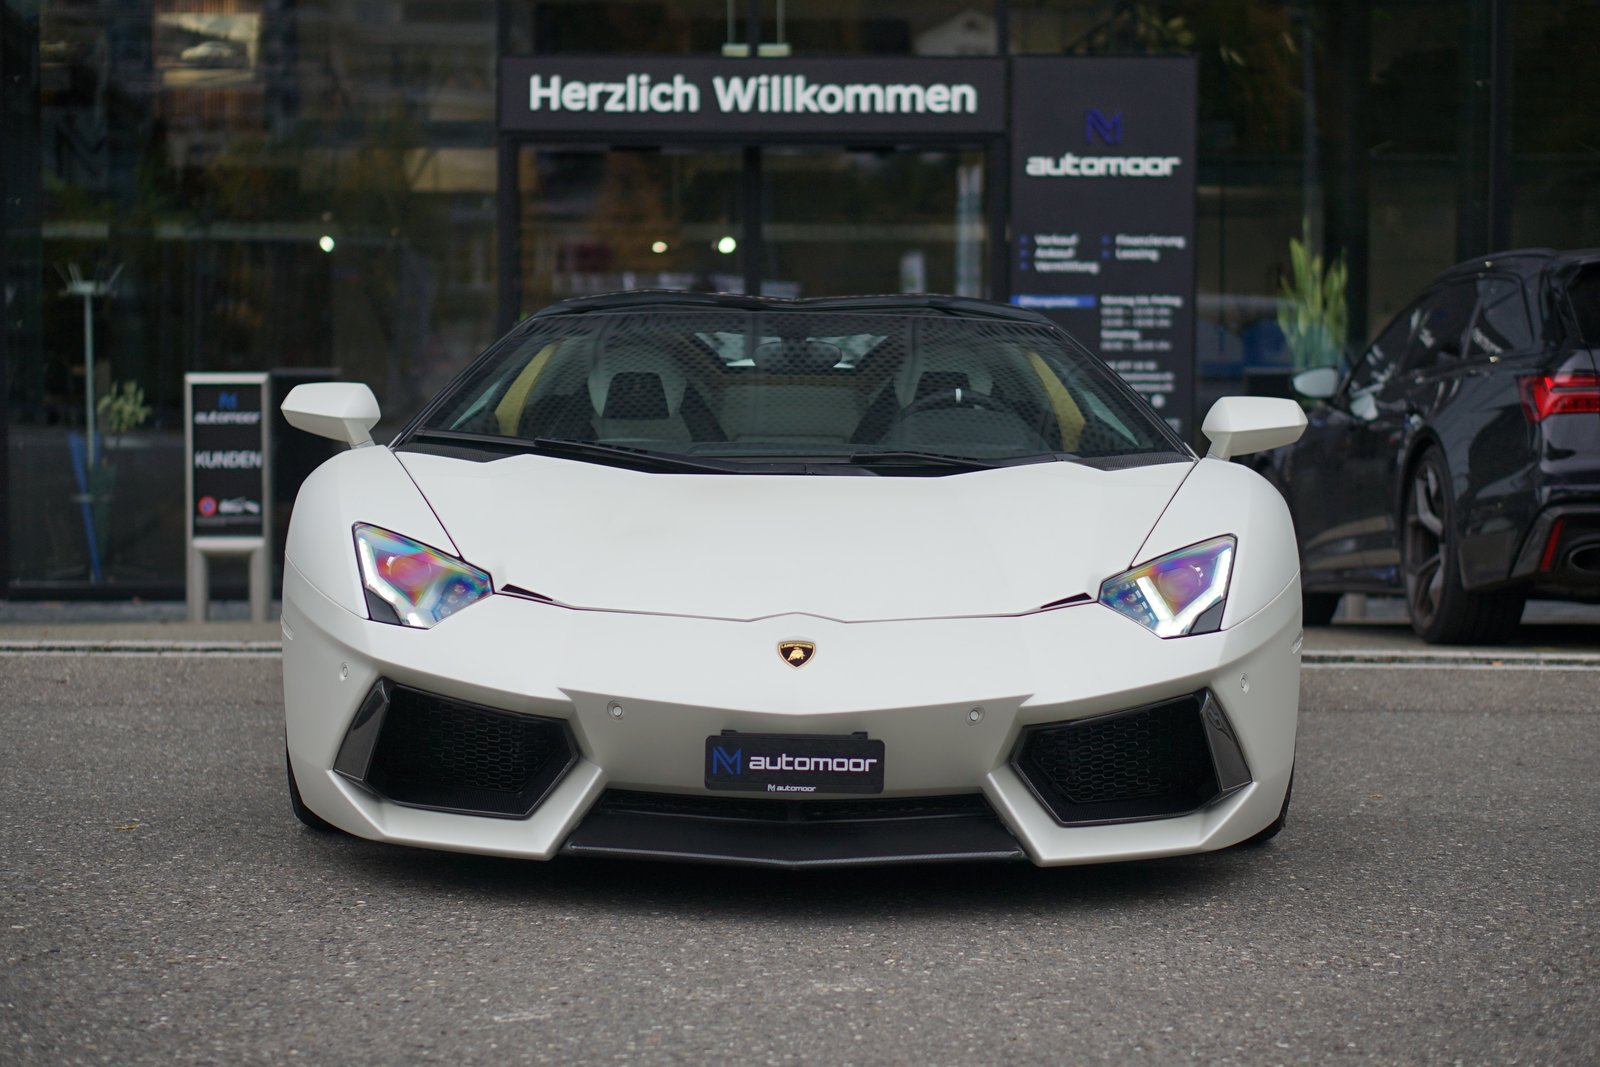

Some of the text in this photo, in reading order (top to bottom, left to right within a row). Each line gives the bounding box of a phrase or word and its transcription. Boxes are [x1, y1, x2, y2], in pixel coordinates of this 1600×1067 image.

[529, 74, 977, 113] Herzlich Willkommen
[1025, 153, 1181, 177] automoor
[195, 411, 260, 424] automoor
[195, 451, 262, 469] KUNDEN
[749, 754, 877, 772] automoor
[776, 784, 816, 792] automoor
